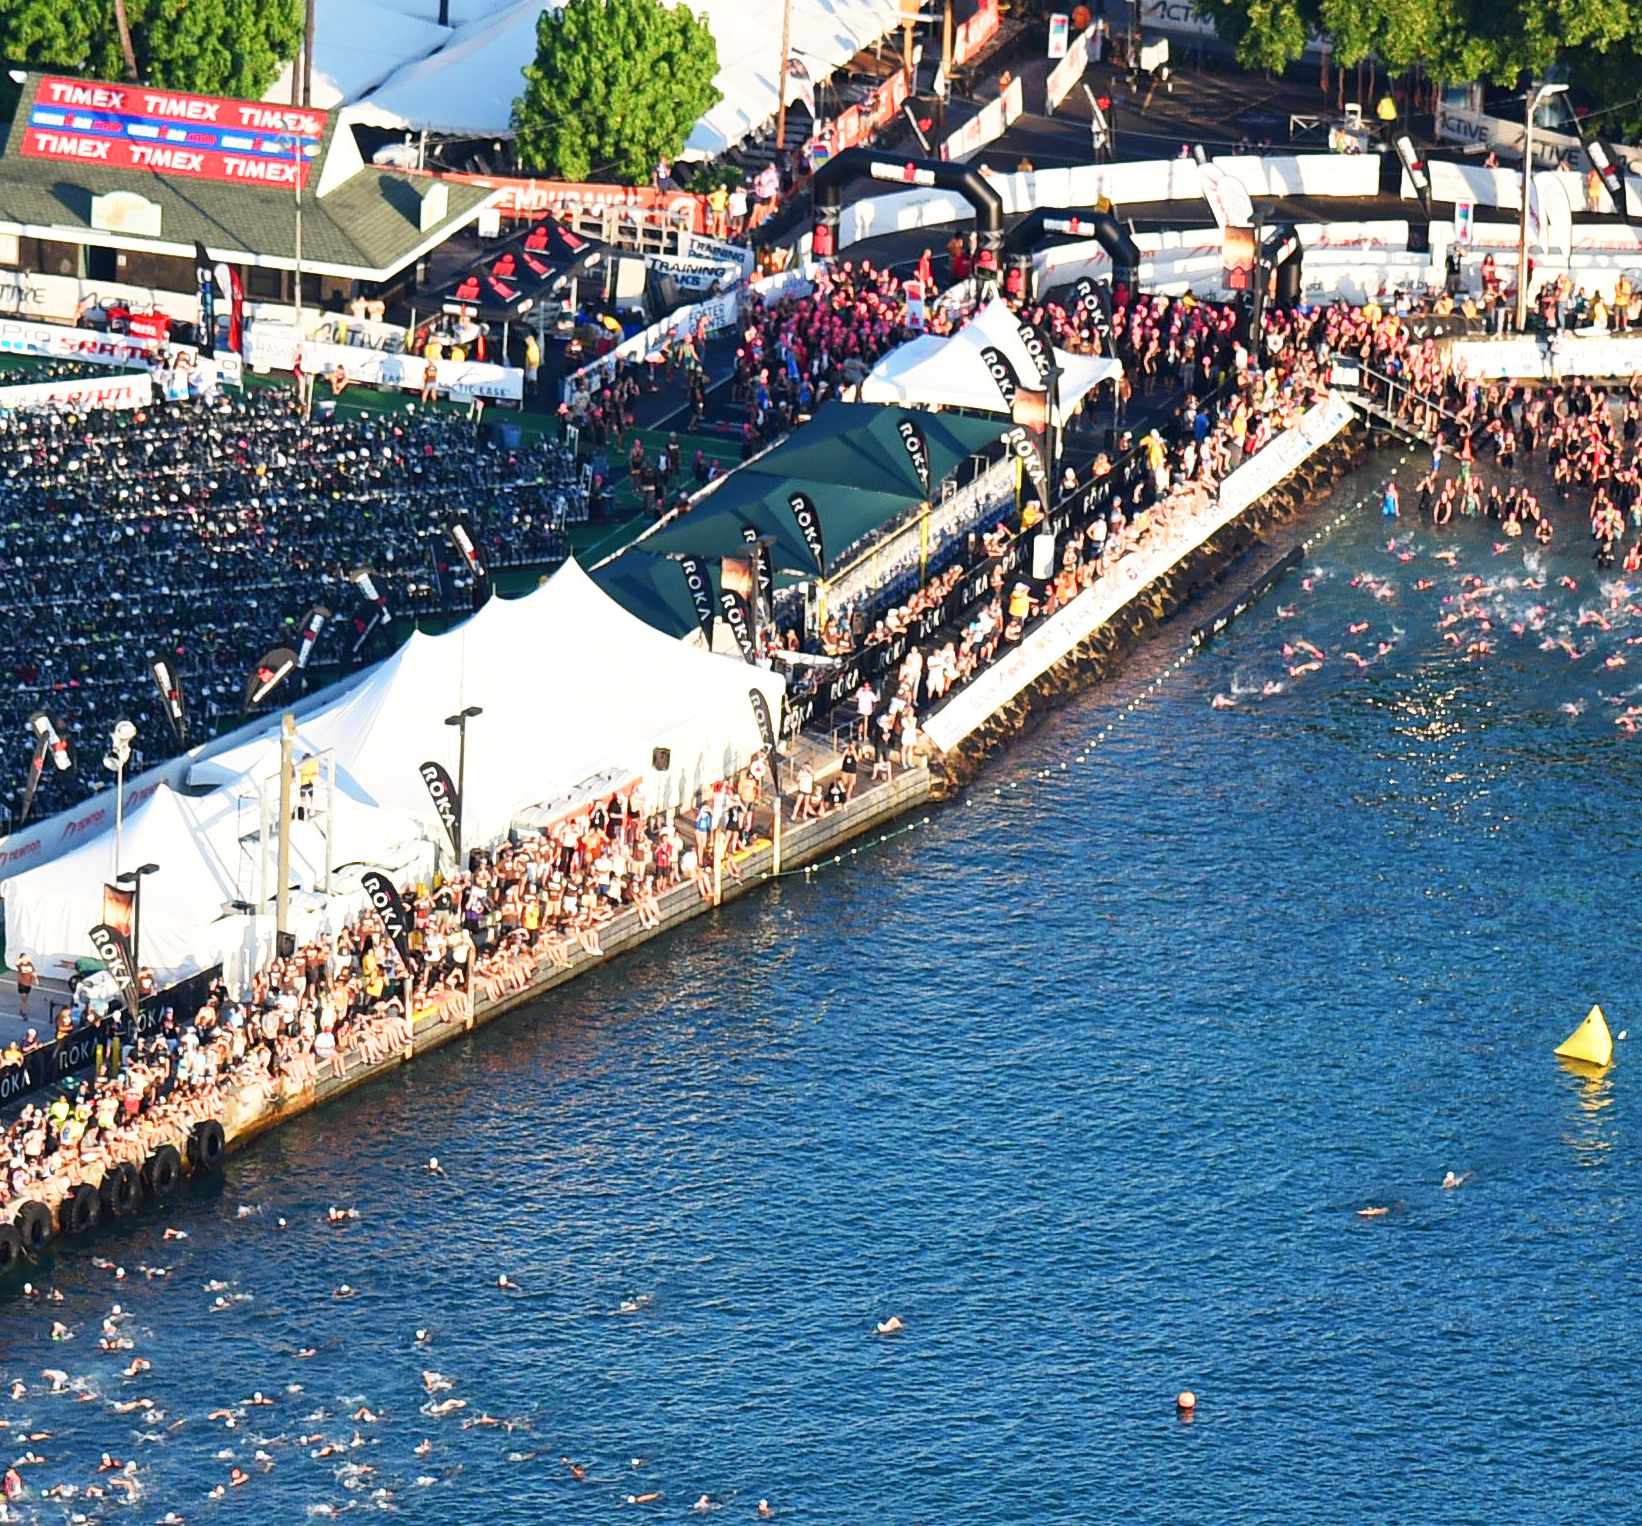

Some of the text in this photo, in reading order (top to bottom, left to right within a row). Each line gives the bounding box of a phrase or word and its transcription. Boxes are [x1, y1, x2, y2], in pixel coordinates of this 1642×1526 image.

[50, 83, 125, 109] TIMEX
[144, 95, 219, 121] TIMEX
[239, 107, 315, 132] TIMEX
[35, 133, 110, 159] TIMEX
[128, 145, 205, 172] TIMEX
[223, 157, 297, 183] TIMEX
[689, 239, 746, 264] TRAINING
[650, 257, 726, 279] TRAINING
[478, 386, 509, 398] EASE
